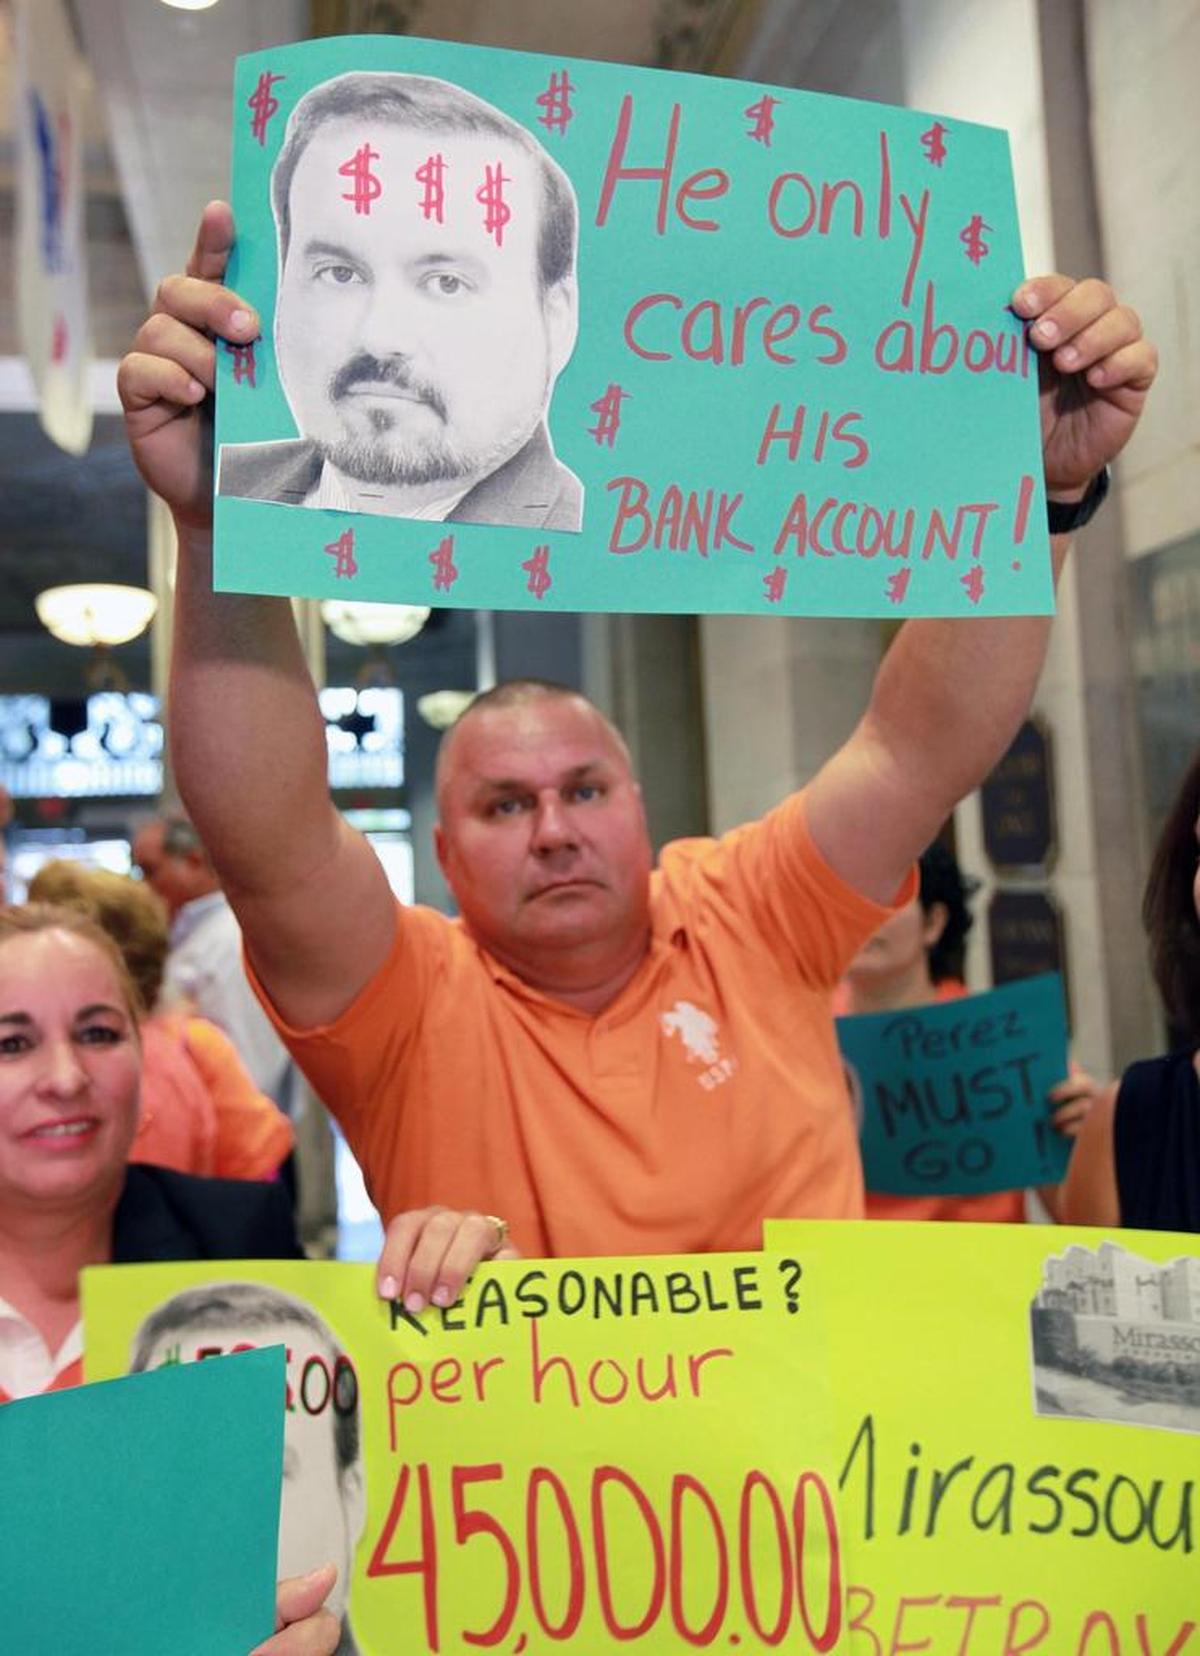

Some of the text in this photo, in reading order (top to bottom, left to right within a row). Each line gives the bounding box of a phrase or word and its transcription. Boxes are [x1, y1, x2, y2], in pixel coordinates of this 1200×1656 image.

[535, 70, 574, 134] $
[594, 94, 931, 307] He only
[623, 294, 847, 365] cares
[757, 404, 869, 468] HIS
[607, 476, 754, 557] BANK
[881, 1010, 1026, 1059] Perez
[874, 1052, 1041, 1139] MUST
[903, 1137, 996, 1182] GO
[386, 1358, 505, 1453] per
[529, 1318, 734, 1408] hour
